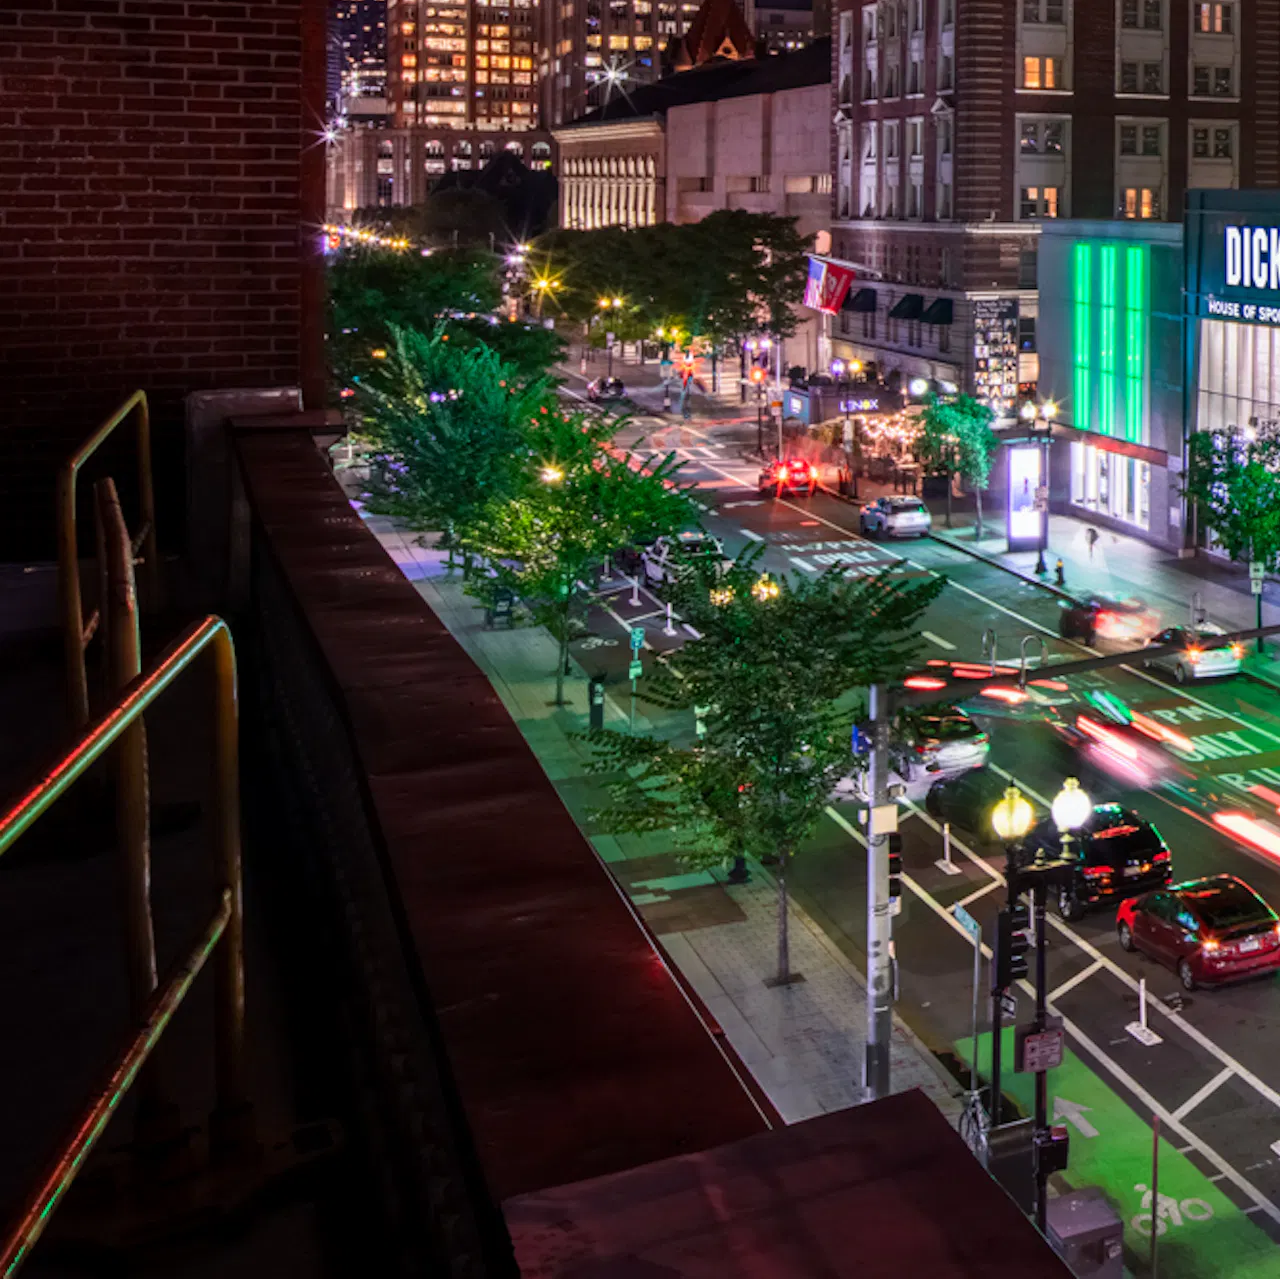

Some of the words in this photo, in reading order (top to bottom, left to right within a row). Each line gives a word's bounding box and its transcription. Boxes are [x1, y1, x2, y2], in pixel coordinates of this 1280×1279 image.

[1208, 300, 1240, 317] HOUSE
[1243, 305, 1257, 319] OF
[1161, 731, 1262, 762] ONLY
